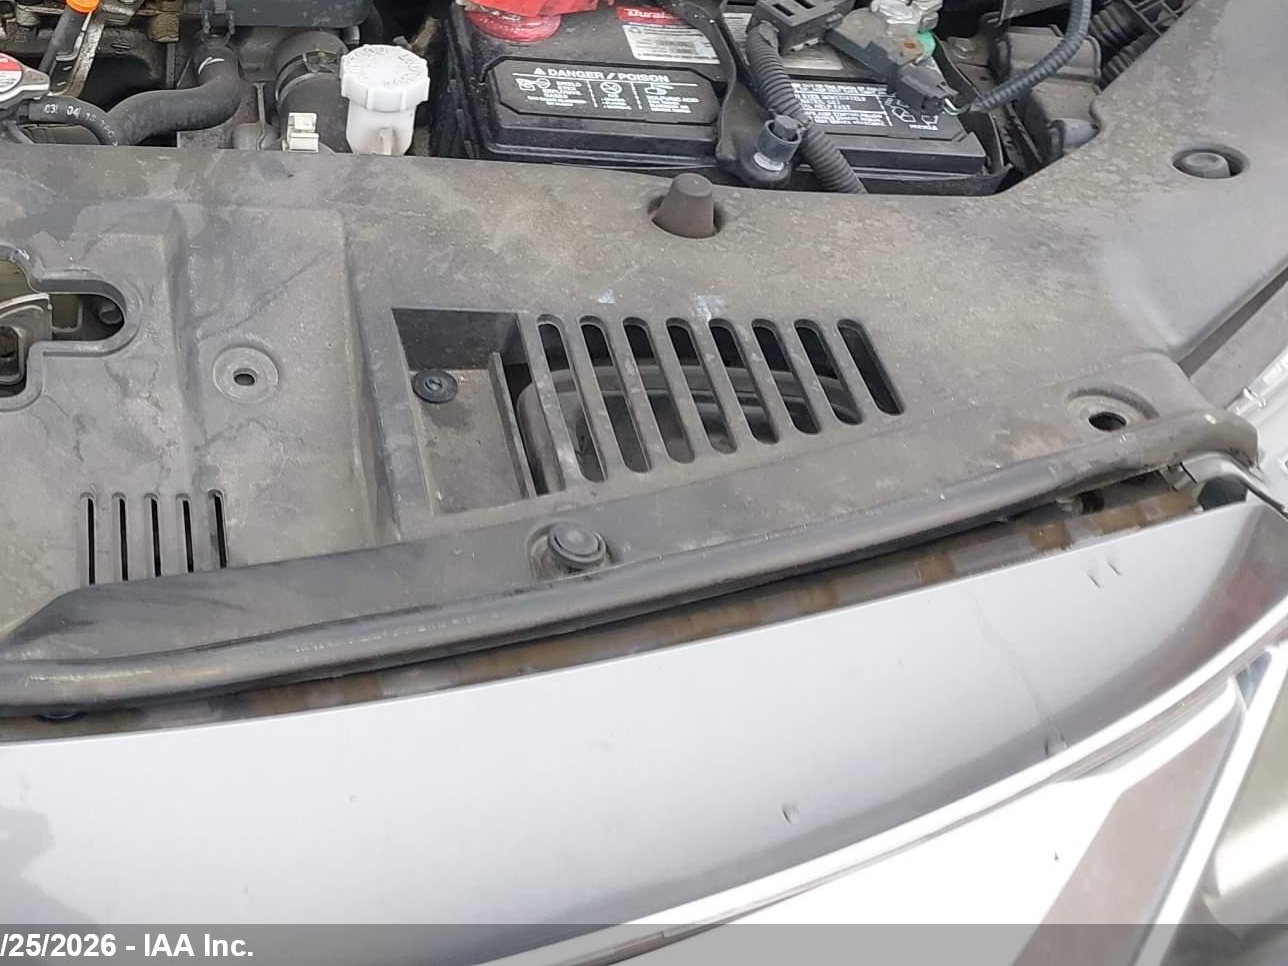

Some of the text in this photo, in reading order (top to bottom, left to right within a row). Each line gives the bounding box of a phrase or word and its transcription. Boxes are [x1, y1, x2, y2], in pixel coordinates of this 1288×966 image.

[624, 8, 674, 20] Dural
[547, 68, 605, 80] DANGER
[617, 72, 670, 83] POISON
